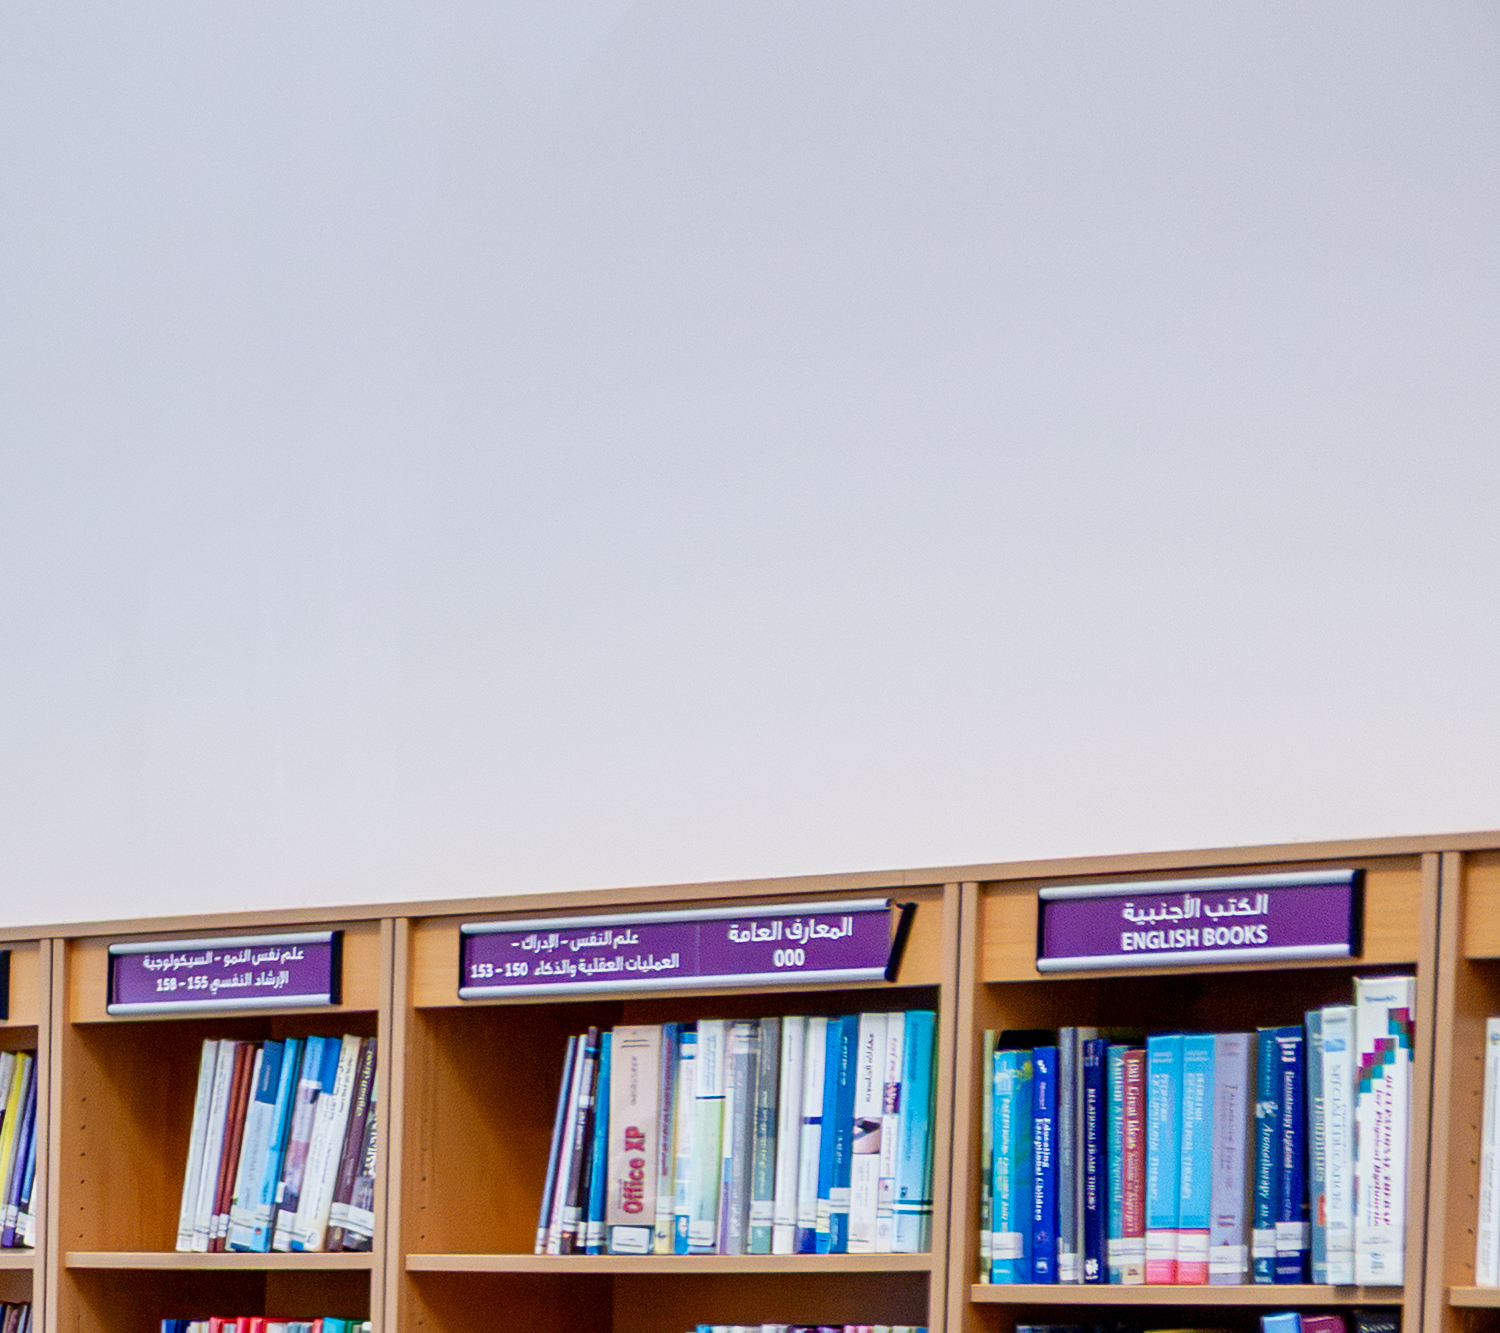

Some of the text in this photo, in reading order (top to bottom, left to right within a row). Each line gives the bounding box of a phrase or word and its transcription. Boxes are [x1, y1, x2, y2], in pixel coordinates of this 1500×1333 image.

[1122, 893, 1269, 925] الكتب الأجنبية
[570, 931, 612, 951] النفس
[613, 932, 639, 949] علم
[728, 917, 853, 944] المعارف العامة
[1121, 925, 1268, 951] ENGLISH BOOKS
[143, 947, 305, 971] علم نفس النمو السيكولوجية
[471, 953, 680, 979] العمليات العقلية والذكاء 150 153
[773, 949, 805, 967] 000
[156, 970, 289, 995] الإرشاد النفسي 155 158
[1113, 1057, 1125, 1102] Autism
[1127, 1059, 1140, 1150] 1001 Great Ideas
[1331, 1064, 1342, 1210] SPECIAL EDUCATION
[1383, 1075, 1393, 1169] OCCUPATIONAL
[1033, 1118, 1044, 1176] Exceptional
[1042, 1118, 1051, 1168] Educating
[1086, 1143, 1096, 1174] FRAME
[621, 1126, 645, 1214] Office XP
[1258, 1122, 1274, 1198] Aromatherapy
[1034, 1178, 1044, 1221] Children
[1086, 1176, 1096, 1210] THEORY
